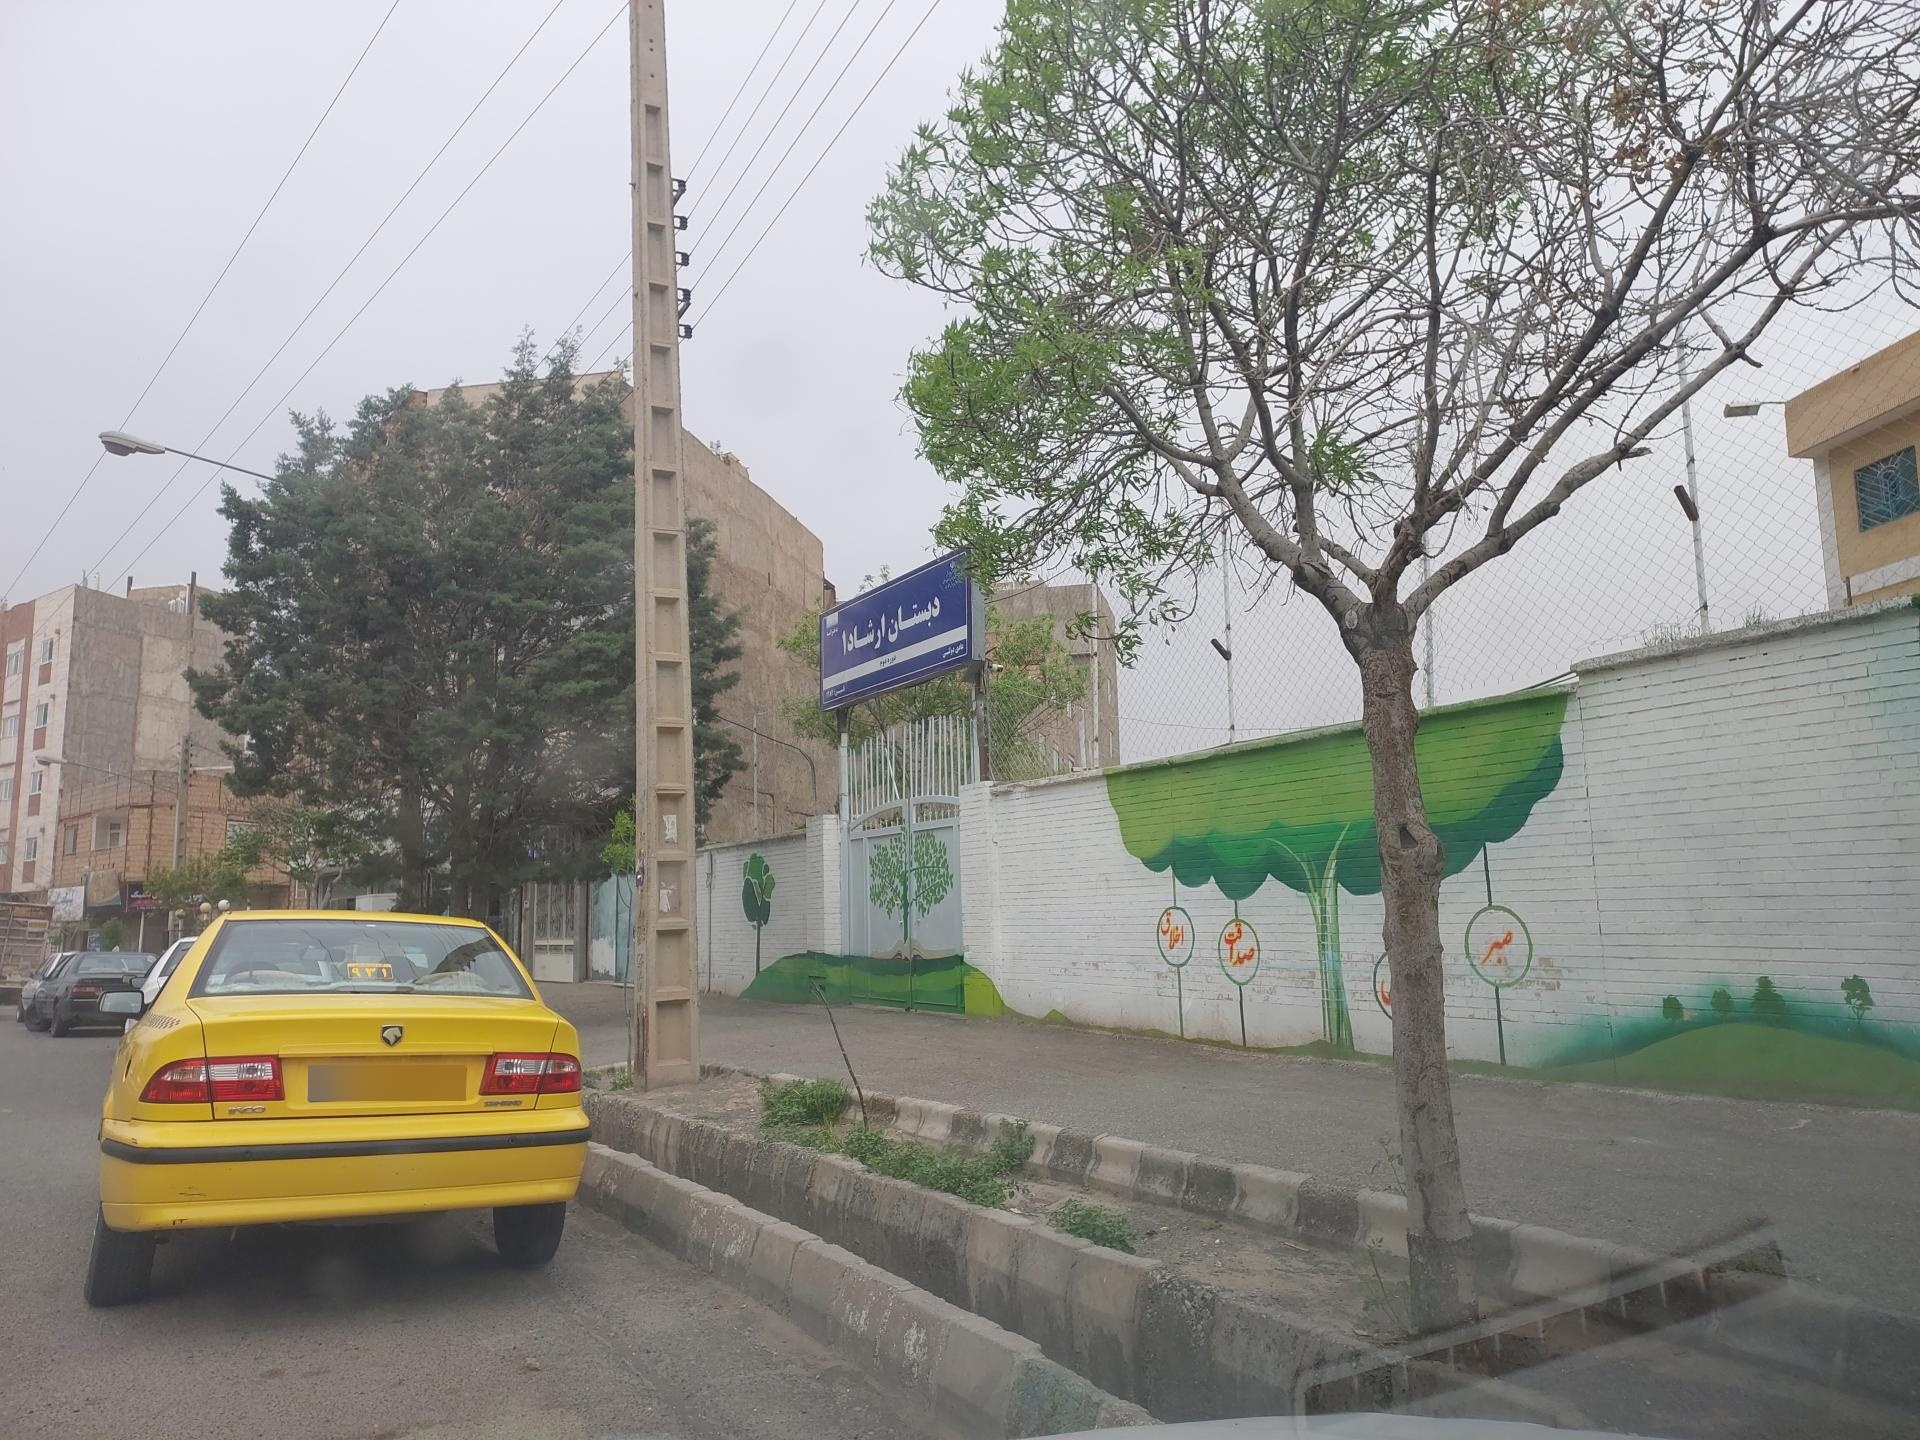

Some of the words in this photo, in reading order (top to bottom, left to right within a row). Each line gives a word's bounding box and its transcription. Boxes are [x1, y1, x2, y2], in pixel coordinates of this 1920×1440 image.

[847, 613, 885, 651] ارشاد
[888, 596, 940, 643] دبستان
[1160, 911, 1185, 950] اخلاق
[1224, 922, 1256, 967] صداقت
[1480, 930, 1514, 966] صبر
